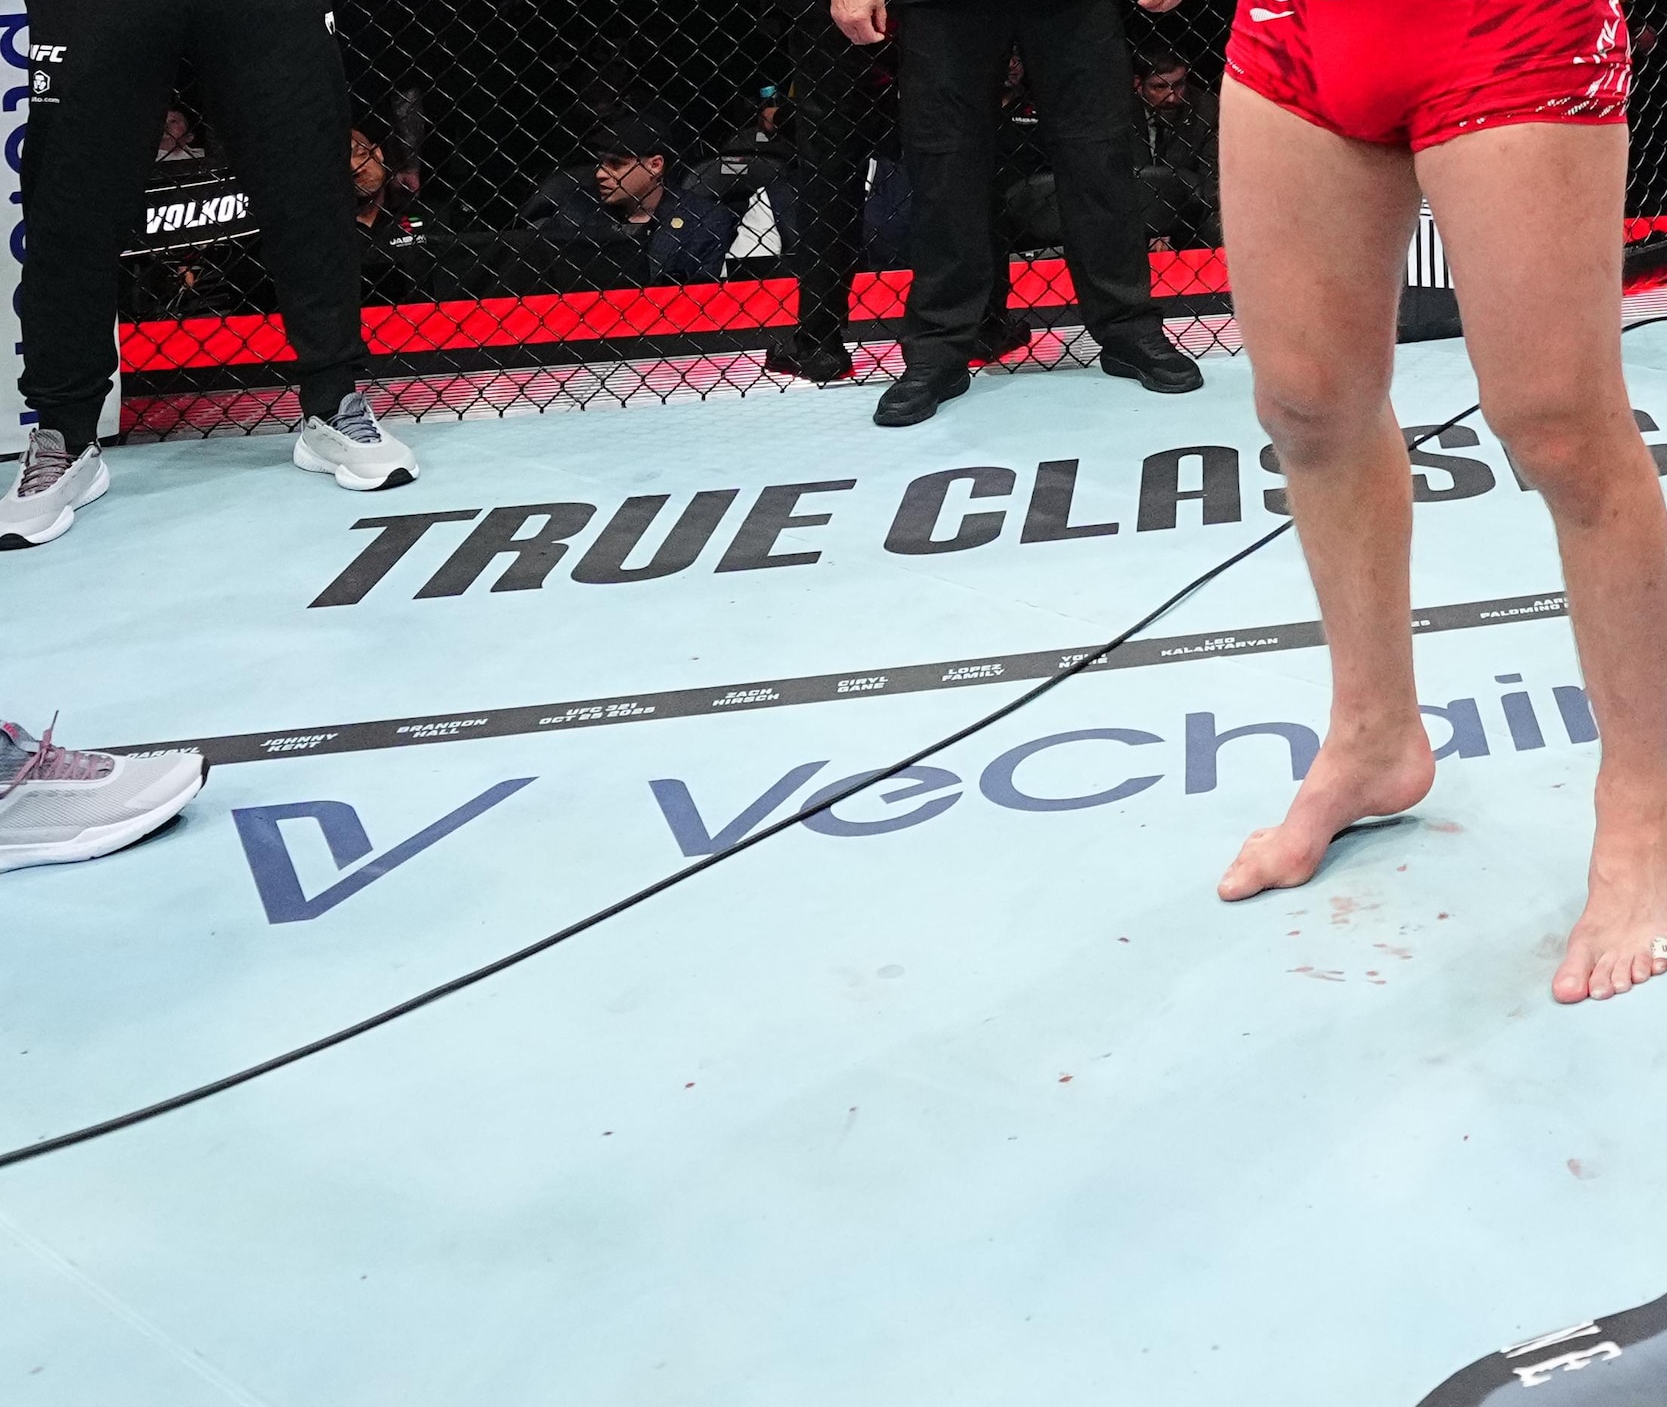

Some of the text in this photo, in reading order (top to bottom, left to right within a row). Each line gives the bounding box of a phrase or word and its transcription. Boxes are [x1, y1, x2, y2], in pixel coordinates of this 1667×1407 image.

[307, 478, 858, 609] TRUE
[1480, 603, 1560, 619] PALOMINO
[1161, 637, 1279, 656] KALANTARYAN
[1205, 636, 1235, 646] LEO
[941, 668, 1005, 682] FAMILY
[948, 663, 1002, 676] LOPEZ
[836, 682, 885, 693] GANE
[837, 675, 889, 688] CIRYL
[712, 693, 780, 707] HIRSCH
[725, 688, 773, 700] ZACH
[538, 706, 656, 725] OCT 25 2025
[566, 702, 638, 717] UFC 321
[396, 718, 488, 734] BRANDON
[413, 727, 460, 739] HALL
[260, 733, 338, 747] JOHNNY
[267, 741, 322, 752] KENT
